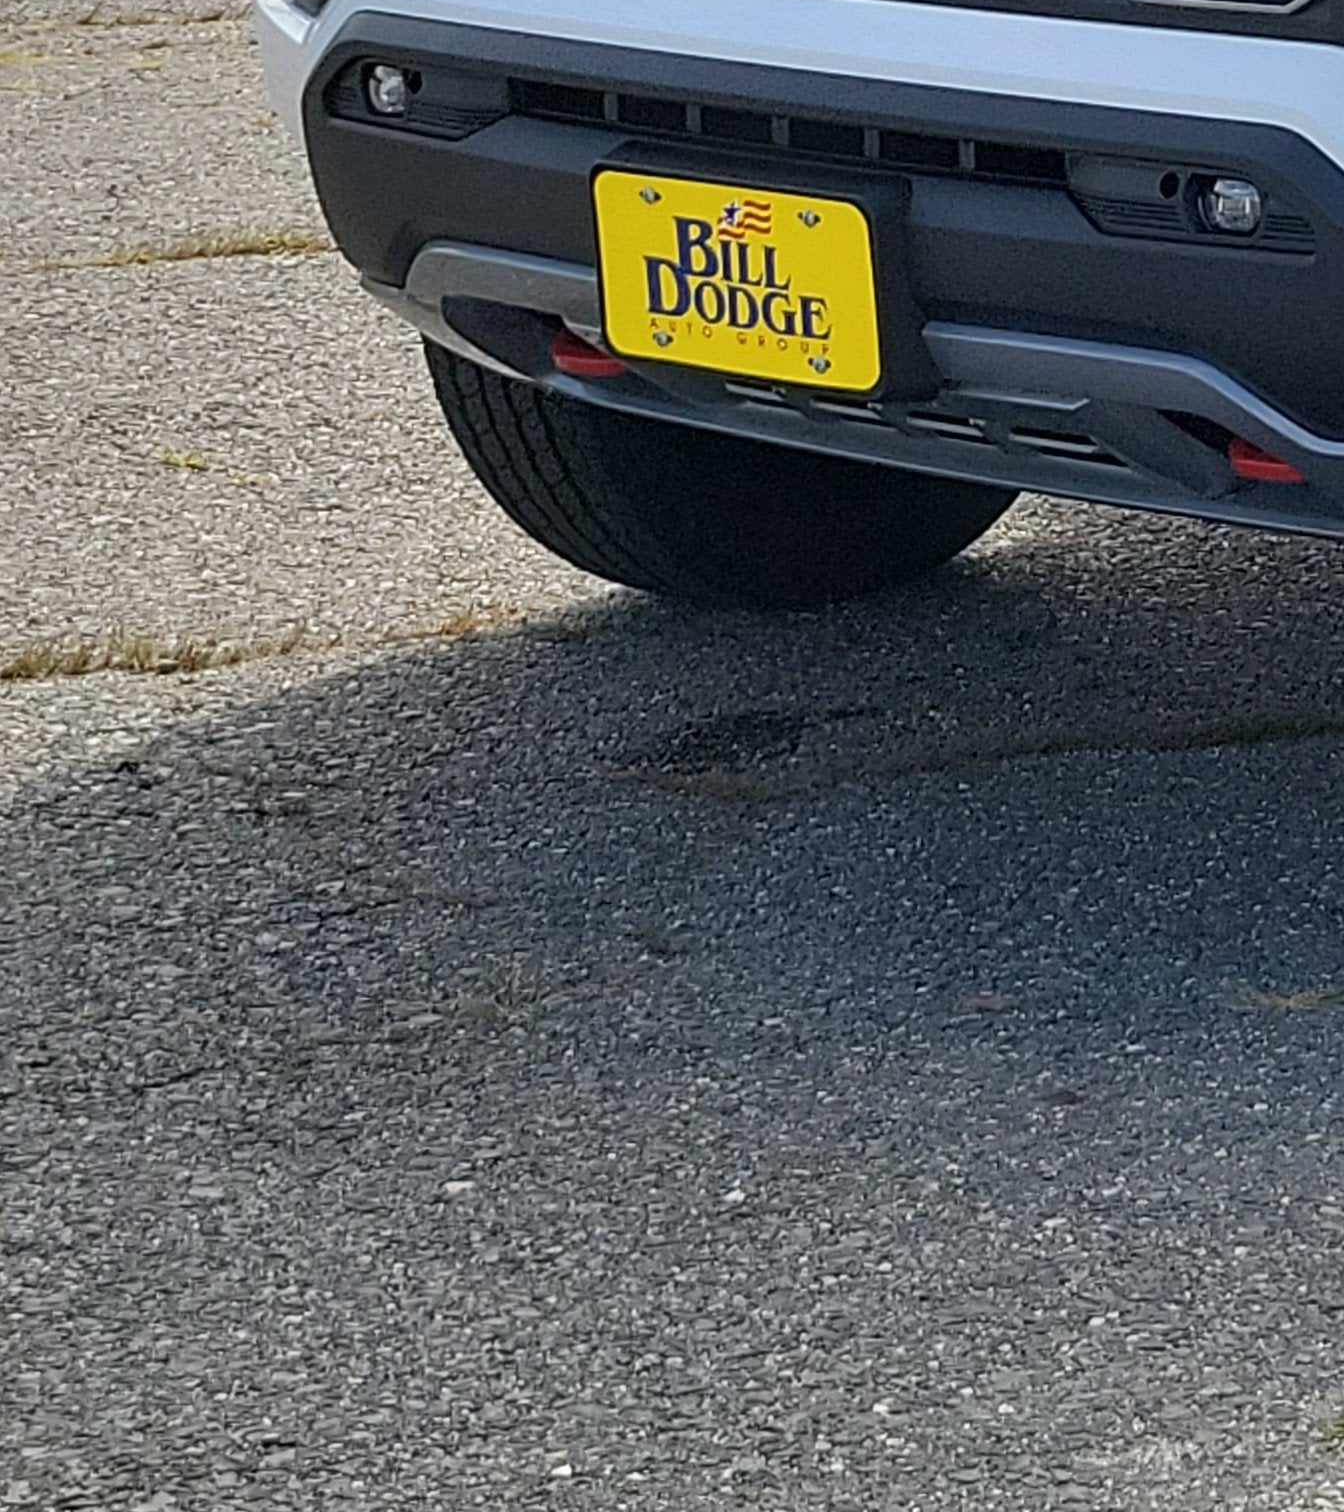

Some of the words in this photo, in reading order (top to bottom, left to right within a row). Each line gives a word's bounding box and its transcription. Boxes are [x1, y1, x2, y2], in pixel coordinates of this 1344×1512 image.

[672, 215, 792, 292] BILL
[642, 255, 833, 341] DODGE
[649, 317, 713, 339] AUTO
[735, 332, 831, 356] GROUP
